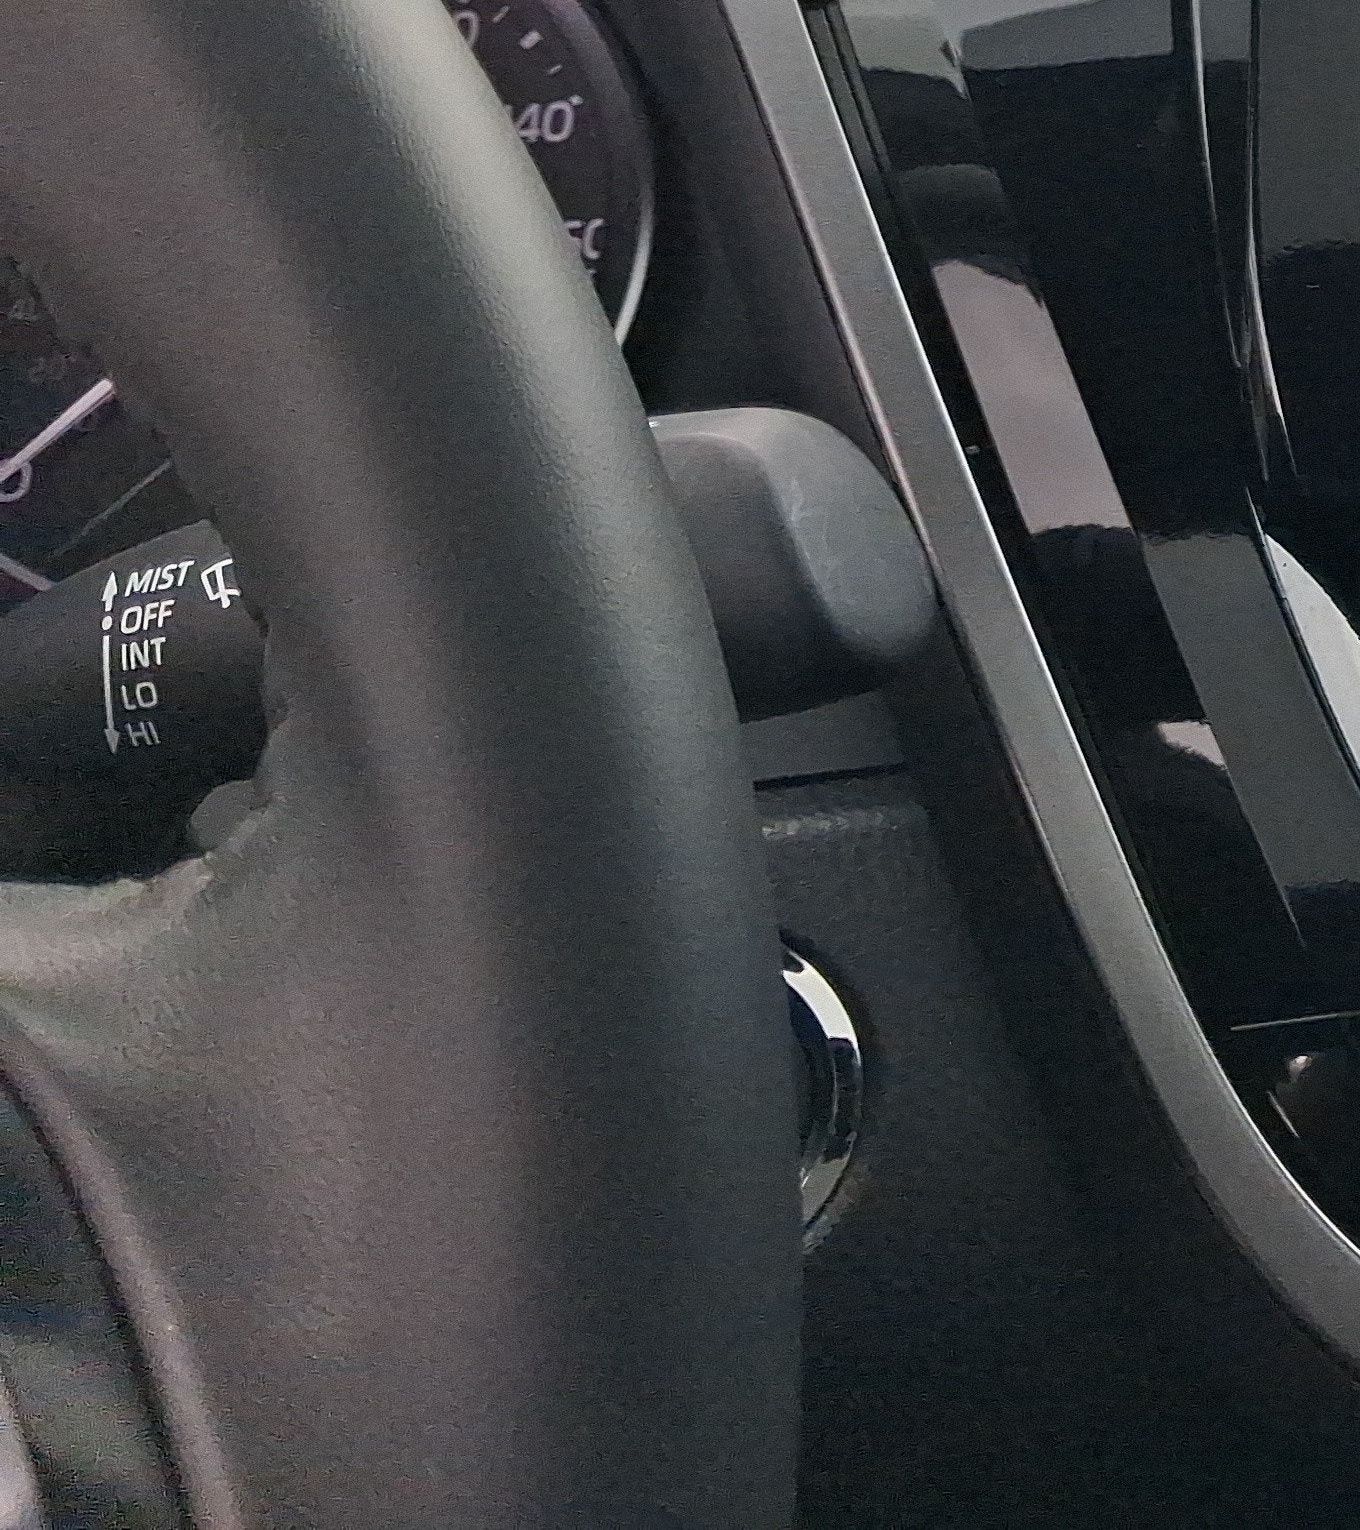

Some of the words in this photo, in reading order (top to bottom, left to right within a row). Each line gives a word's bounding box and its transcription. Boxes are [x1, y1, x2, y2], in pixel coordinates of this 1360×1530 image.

[504, 99, 575, 143] 40
[123, 559, 195, 598] MIST
[120, 599, 175, 635] OFF
[121, 636, 167, 672] INT
[121, 681, 158, 711] LO
[128, 720, 161, 747] HI
